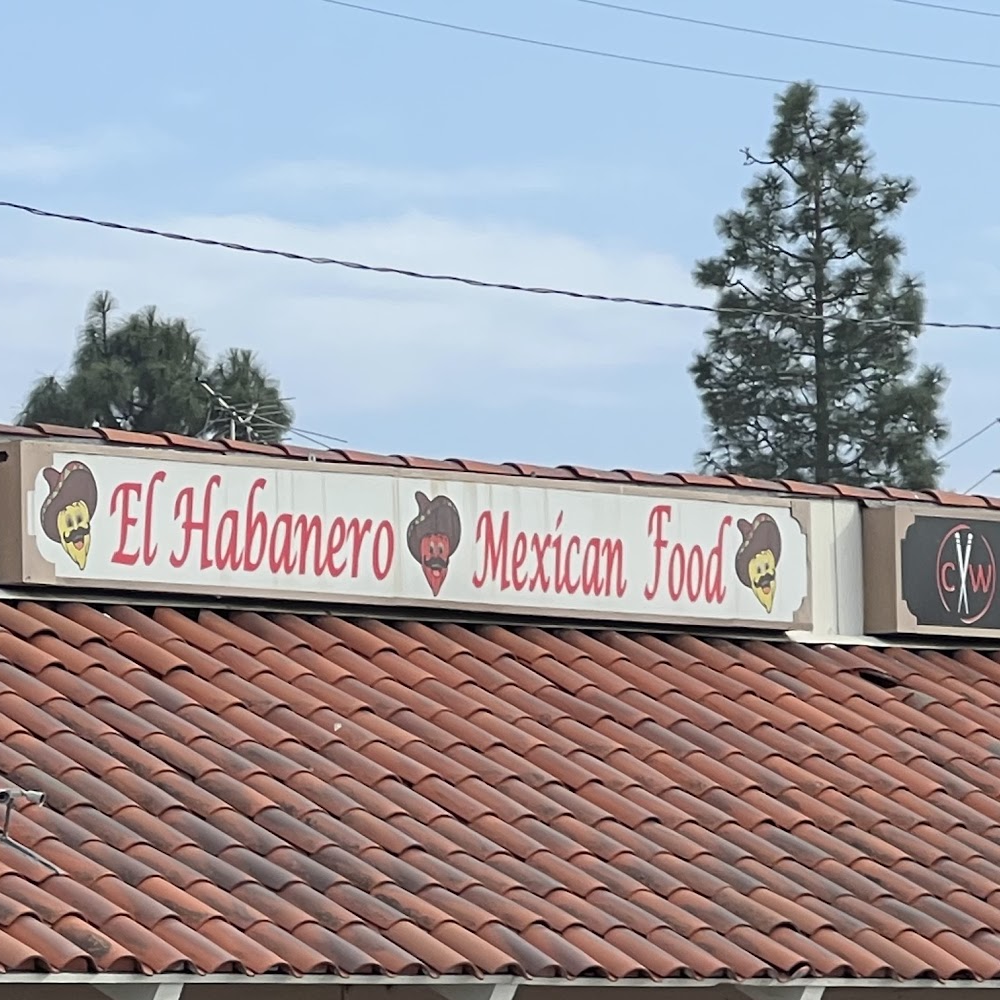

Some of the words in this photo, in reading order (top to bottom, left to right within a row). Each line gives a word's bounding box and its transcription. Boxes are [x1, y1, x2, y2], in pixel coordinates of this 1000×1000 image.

[109, 470, 166, 567] El
[169, 474, 395, 581] Habanero
[643, 505, 733, 604] Food
